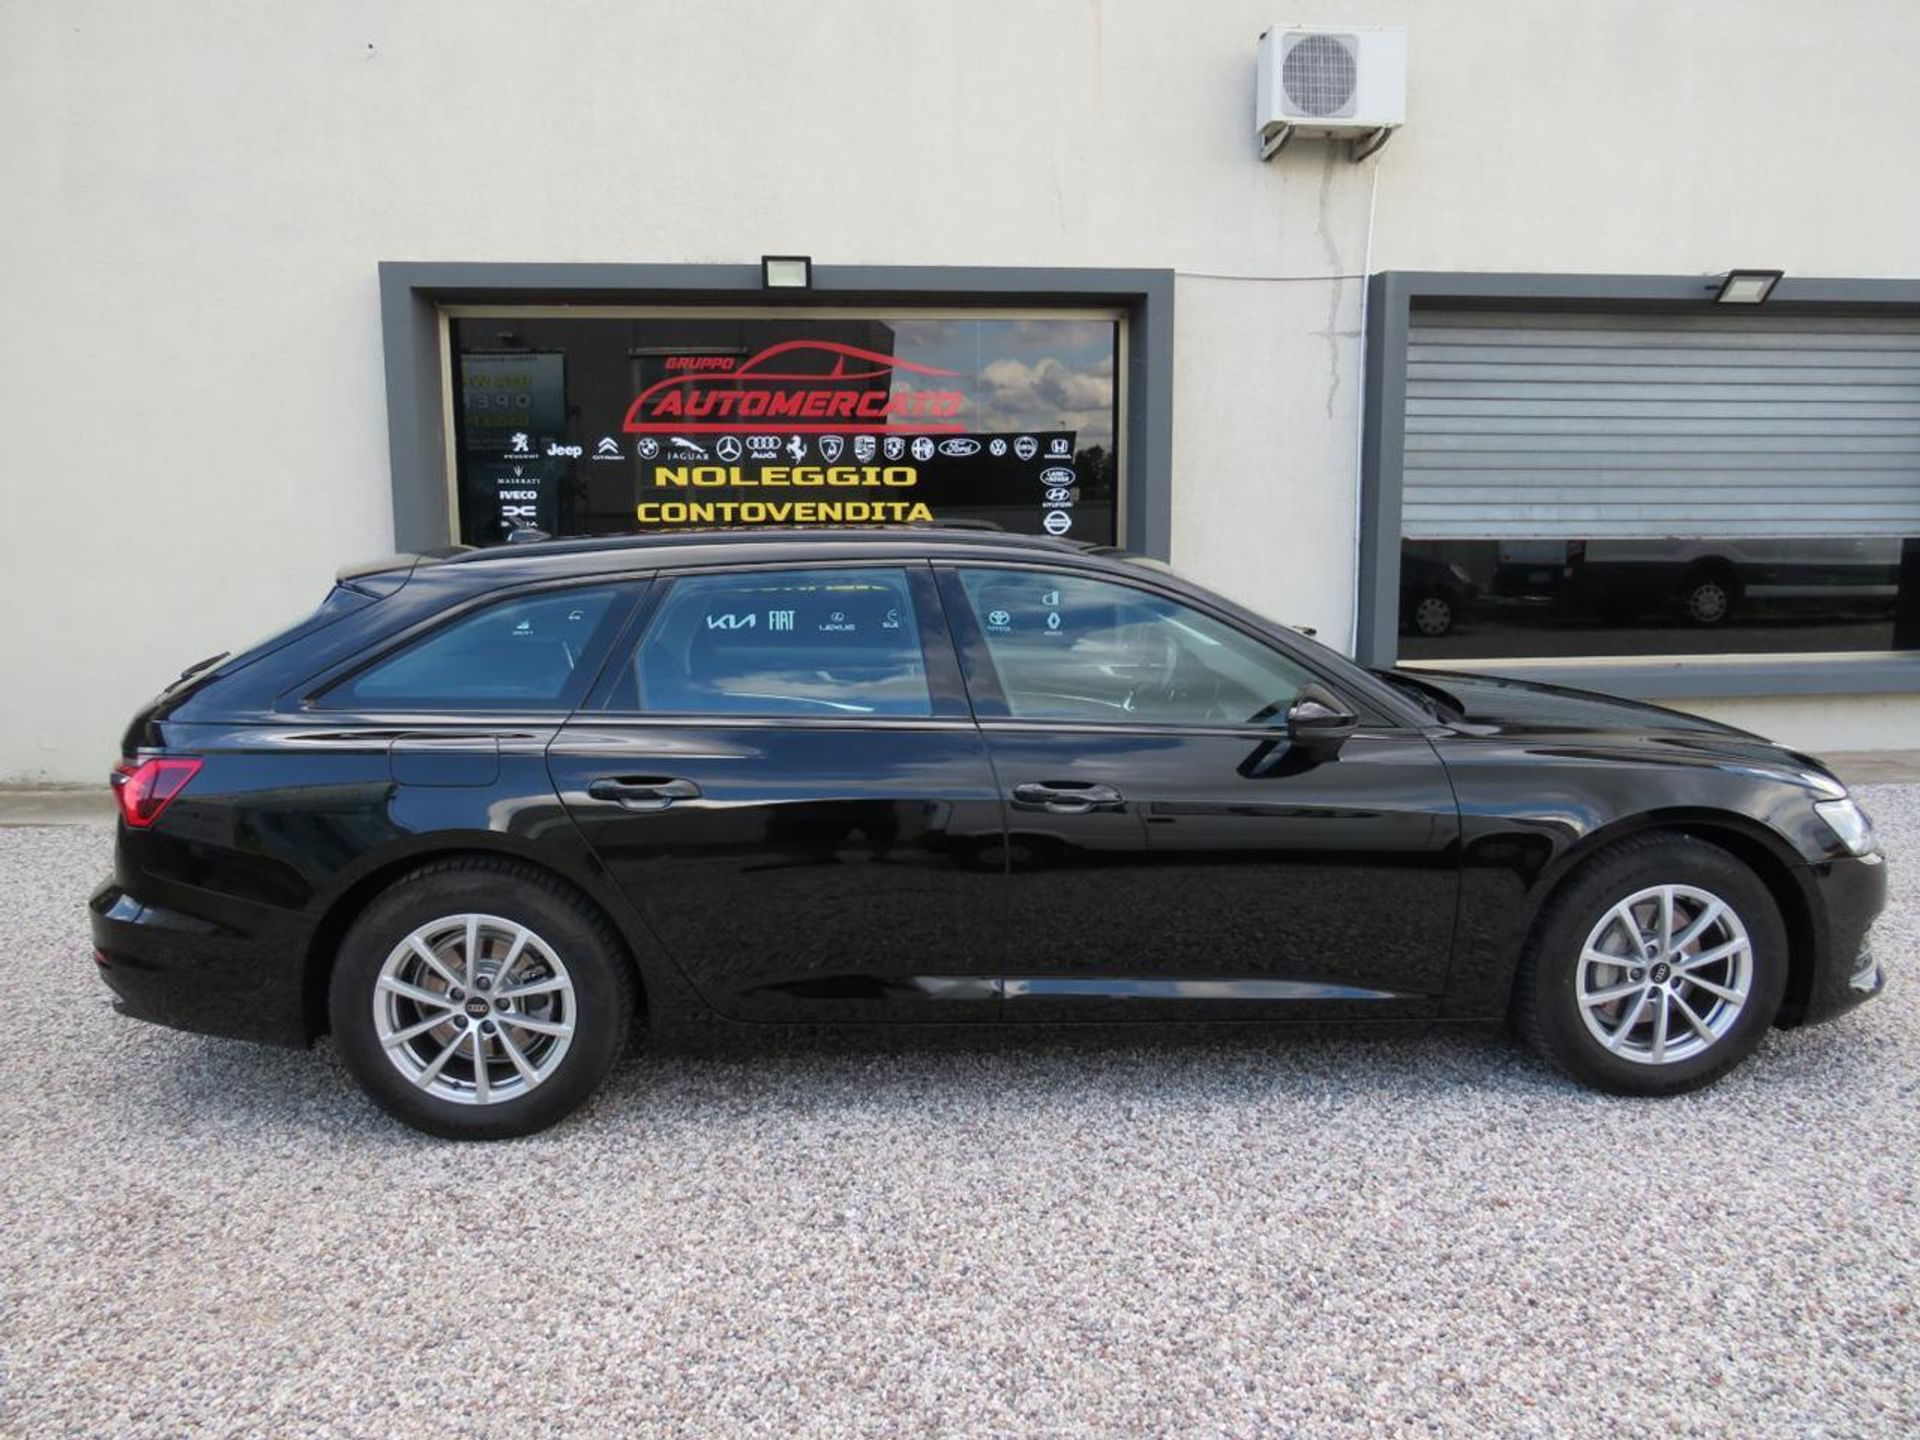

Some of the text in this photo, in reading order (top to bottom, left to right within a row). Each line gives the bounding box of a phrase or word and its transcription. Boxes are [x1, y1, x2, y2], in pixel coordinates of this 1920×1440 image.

[665, 357, 735, 370] GRUPPO
[653, 391, 963, 417] AUTOMERCATO
[546, 443, 583, 458] Jeep
[946, 440, 972, 454] Ford
[667, 452, 709, 460] JAGUAR
[751, 451, 777, 459] Audi
[655, 466, 917, 487] NOLEGGIO
[499, 490, 538, 500] IVECO
[637, 502, 934, 523] CONTOVENDITA
[501, 520, 538, 528] DIA
[768, 610, 795, 631] FIAT
